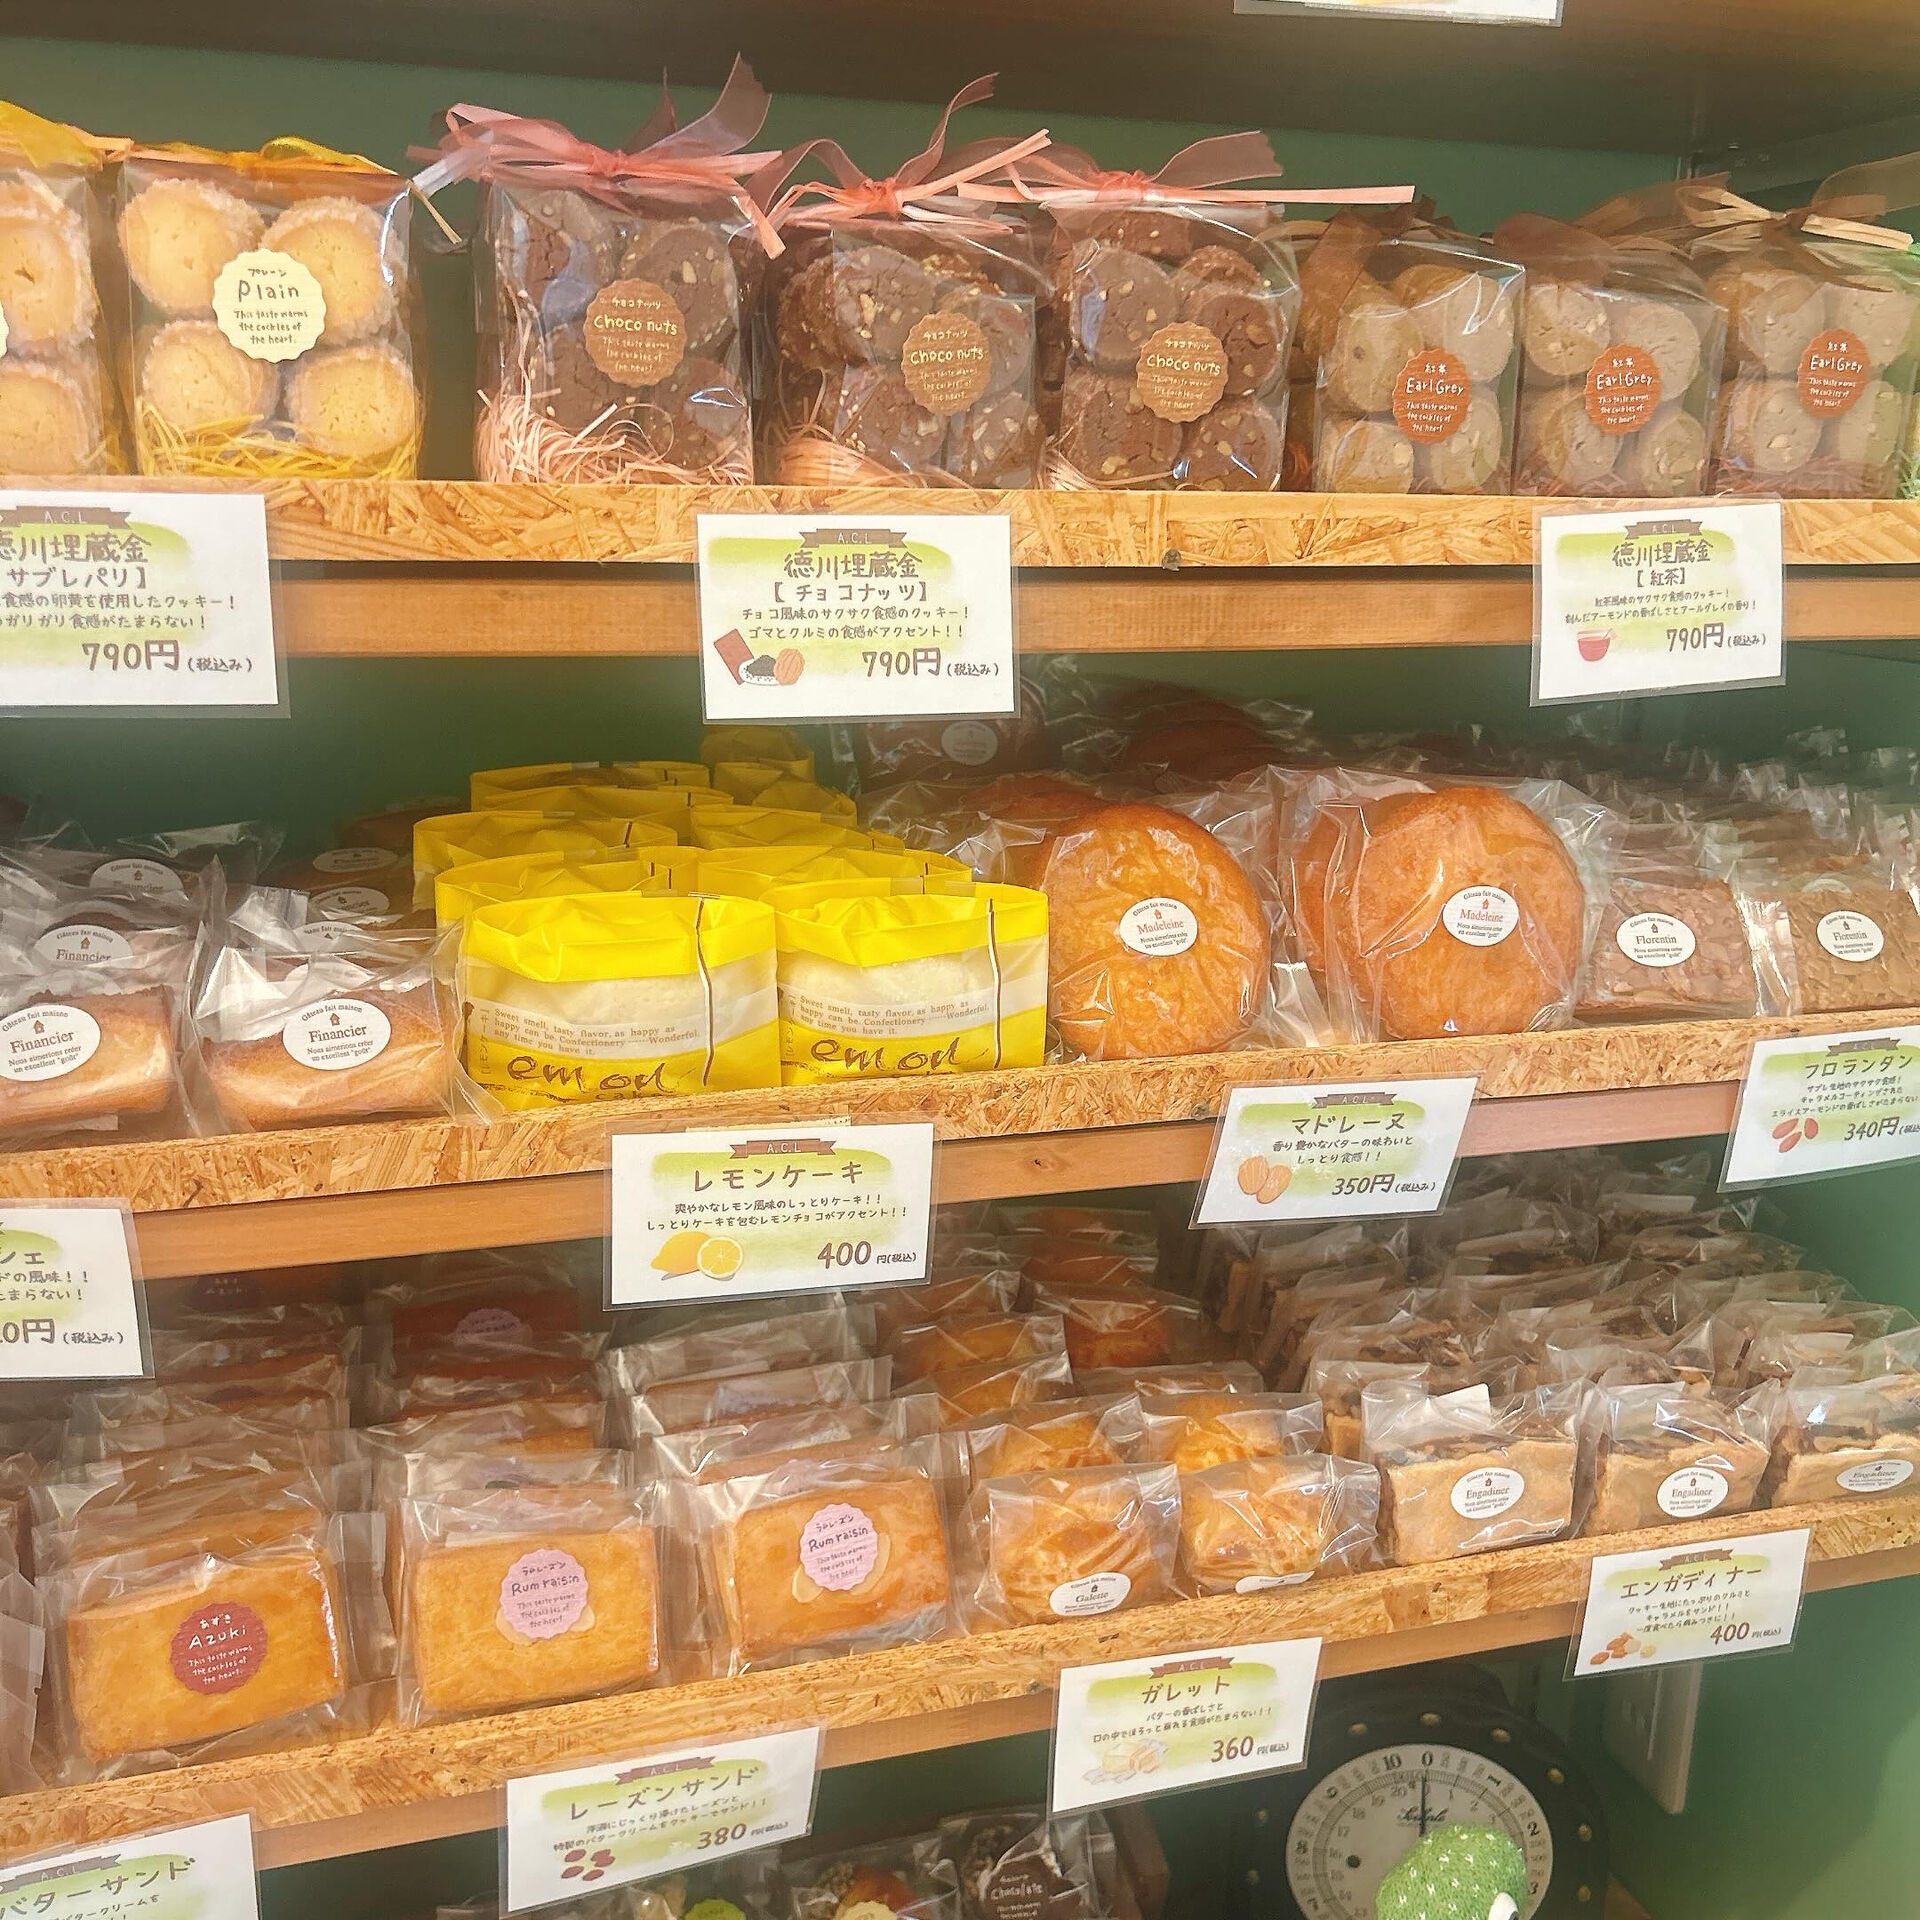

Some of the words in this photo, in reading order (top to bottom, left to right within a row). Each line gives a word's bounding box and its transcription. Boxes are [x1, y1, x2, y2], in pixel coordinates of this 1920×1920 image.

[238, 279, 300, 303] Plain
[233, 310, 253, 319] This
[255, 310, 278, 319] taste
[280, 310, 308, 318] warms
[238, 322, 254, 331] the
[256, 322, 290, 331] cockles
[292, 322, 302, 331] of
[646, 319, 678, 336] nuts
[250, 335, 265, 344] the
[957, 345, 983, 360] nuts
[1810, 354, 1835, 371] Earl
[1837, 357, 1863, 373] Grey
[1193, 361, 1221, 377] nuts
[1405, 376, 1433, 394] Earl
[1436, 379, 1464, 396] Grey
[1596, 372, 1622, 390] Earl
[1625, 371, 1653, 387] Grey
[1611, 538, 1713, 567] 徳川埋蔵金
[783, 550, 923, 580] 徳川埋蔵金
[0, 591, 235, 609] 食感の卵黄を使用したクッキー！
[1459, 909, 1504, 922] Madeleine
[1136, 919, 1184, 935] Madeleine
[1635, 934, 1677, 945] Florentin
[800, 995, 824, 1009] Sweet
[858, 1009, 880, 1018] tasty
[930, 1004, 955, 1015] happy
[801, 1005, 824, 1018] happy
[827, 1013, 843, 1023] can
[863, 1018, 925, 1027] Confectionery
[494, 1008, 520, 1022] Sweet
[554, 1025, 574, 1037] tasty
[630, 1028, 659, 1037] happy
[495, 1018, 520, 1032] happy
[524, 1027, 539, 1037] can
[560, 1035, 625, 1048] Confectionery
[800, 1014, 814, 1025] any
[818, 1019, 837, 1030] time
[841, 1025, 857, 1033] you
[862, 1027, 883, 1035] have
[9, 1031, 75, 1054] Financier
[308, 1025, 367, 1043] Financier
[494, 1028, 509, 1039] any
[514, 1033, 533, 1045] time
[537, 1040, 553, 1050] you
[559, 1044, 580, 1054] have
[1805, 1055, 1913, 1079] フロランタン
[1291, 1112, 1406, 1136] マドレーヌ
[1273, 1136, 1413, 1152] 香り豊かなバターの味わいと
[694, 1160, 864, 1192] レモンケーキ
[817, 1240, 872, 1270] 400
[0, 1319, 55, 1344] 0円
[1465, 1486, 1510, 1500] Engadiner
[1671, 1487, 1713, 1498] Engadiner
[808, 1537, 834, 1553] Rum
[836, 1527, 869, 1543] raisin
[511, 1582, 540, 1597] Rum
[542, 1575, 580, 1589] raisin
[1620, 1565, 1762, 1599] エンガディナー
[1075, 1591, 1109, 1603] Galette
[188, 1624, 246, 1650] Azuki
[1710, 1621, 1750, 1646] 400
[1141, 1675, 1230, 1704] ガレット
[1211, 1735, 1255, 1763] 360
[1382, 1752, 1402, 1771] 10
[1421, 1750, 1433, 1767] 0
[571, 1766, 759, 1820] レーズンサンド
[697, 1823, 748, 1849] 380
[1527, 1821, 1540, 1836] 2
